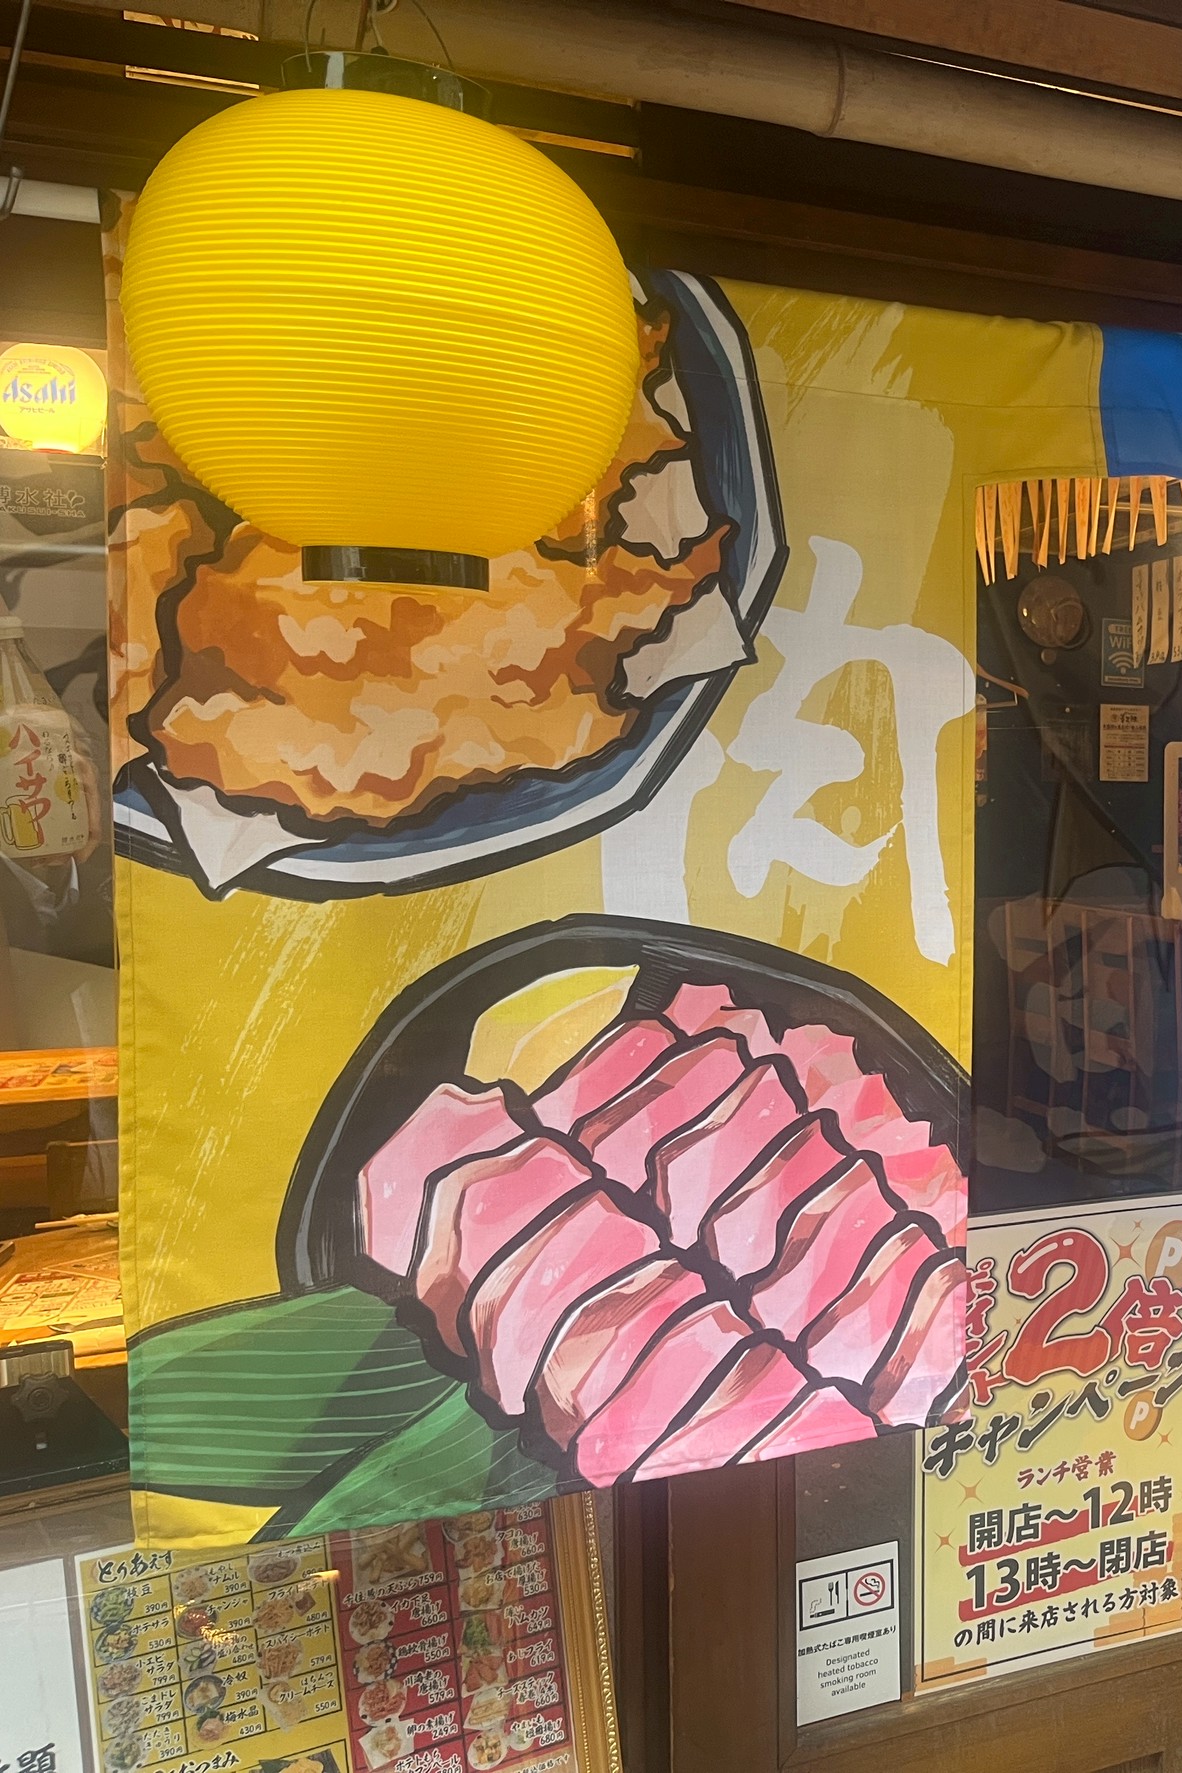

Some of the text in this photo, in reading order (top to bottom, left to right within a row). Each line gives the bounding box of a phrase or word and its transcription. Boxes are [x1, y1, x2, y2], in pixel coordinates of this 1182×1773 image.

[3, 375, 76, 404] Asahi
[8, 723, 51, 846] ハイサワー
[1017, 1450, 1117, 1489] ランチ営業
[519, 1508, 540, 1520] 630円
[497, 1528, 522, 1543] タコの
[521, 1544, 544, 1557] 660円
[212, 1574, 240, 1585] ナムル
[419, 1573, 443, 1586] 759円
[125, 1583, 153, 1598] 枝豆
[225, 1582, 248, 1593] 390円
[524, 1583, 548, 1595] 530円
[145, 1602, 168, 1613] 390円
[206, 1597, 249, 1614] チャンジャ
[306, 1612, 328, 1622] 480円
[421, 1612, 447, 1626] 660円
[508, 1606, 549, 1628] ハムカツ
[953, 1578, 1179, 1648] の間に来店される方対象
[131, 1618, 170, 1635] ポテサラ
[229, 1617, 252, 1629] 390円
[528, 1619, 552, 1632] 649円
[265, 1624, 331, 1648] スパイシーポテト
[798, 1625, 897, 1657] 加熱式たばこ専用喫煙室あり
[148, 1638, 172, 1649] 530円
[507, 1639, 552, 1661] あじフライ
[136, 1652, 164, 1669] 小エビ
[232, 1653, 255, 1664] 480円
[310, 1655, 332, 1667] 579円
[425, 1649, 450, 1662] 550円
[530, 1654, 555, 1667] 619円
[826, 1648, 871, 1667] Designated
[147, 1661, 175, 1675] サラダ
[817, 1658, 879, 1679] heated tobacco
[152, 1674, 176, 1686] 799円
[222, 1671, 248, 1687] 冷奴
[820, 1668, 877, 1689] smoking room
[235, 1688, 259, 1700] 390円
[279, 1680, 336, 1702] クリームチーズ
[429, 1690, 454, 1703] 579円
[831, 1682, 866, 1697] available
[144, 1700, 173, 1714] サラダ
[315, 1700, 338, 1712] 550円
[534, 1694, 559, 1707] 660円
[155, 1711, 180, 1722] 799円
[224, 1706, 260, 1722] 梅水晶
[239, 1724, 263, 1737] 430円
[432, 1725, 458, 1740] 249円
[540, 1731, 564, 1746] 680円
[159, 1747, 183, 1759] 390円
